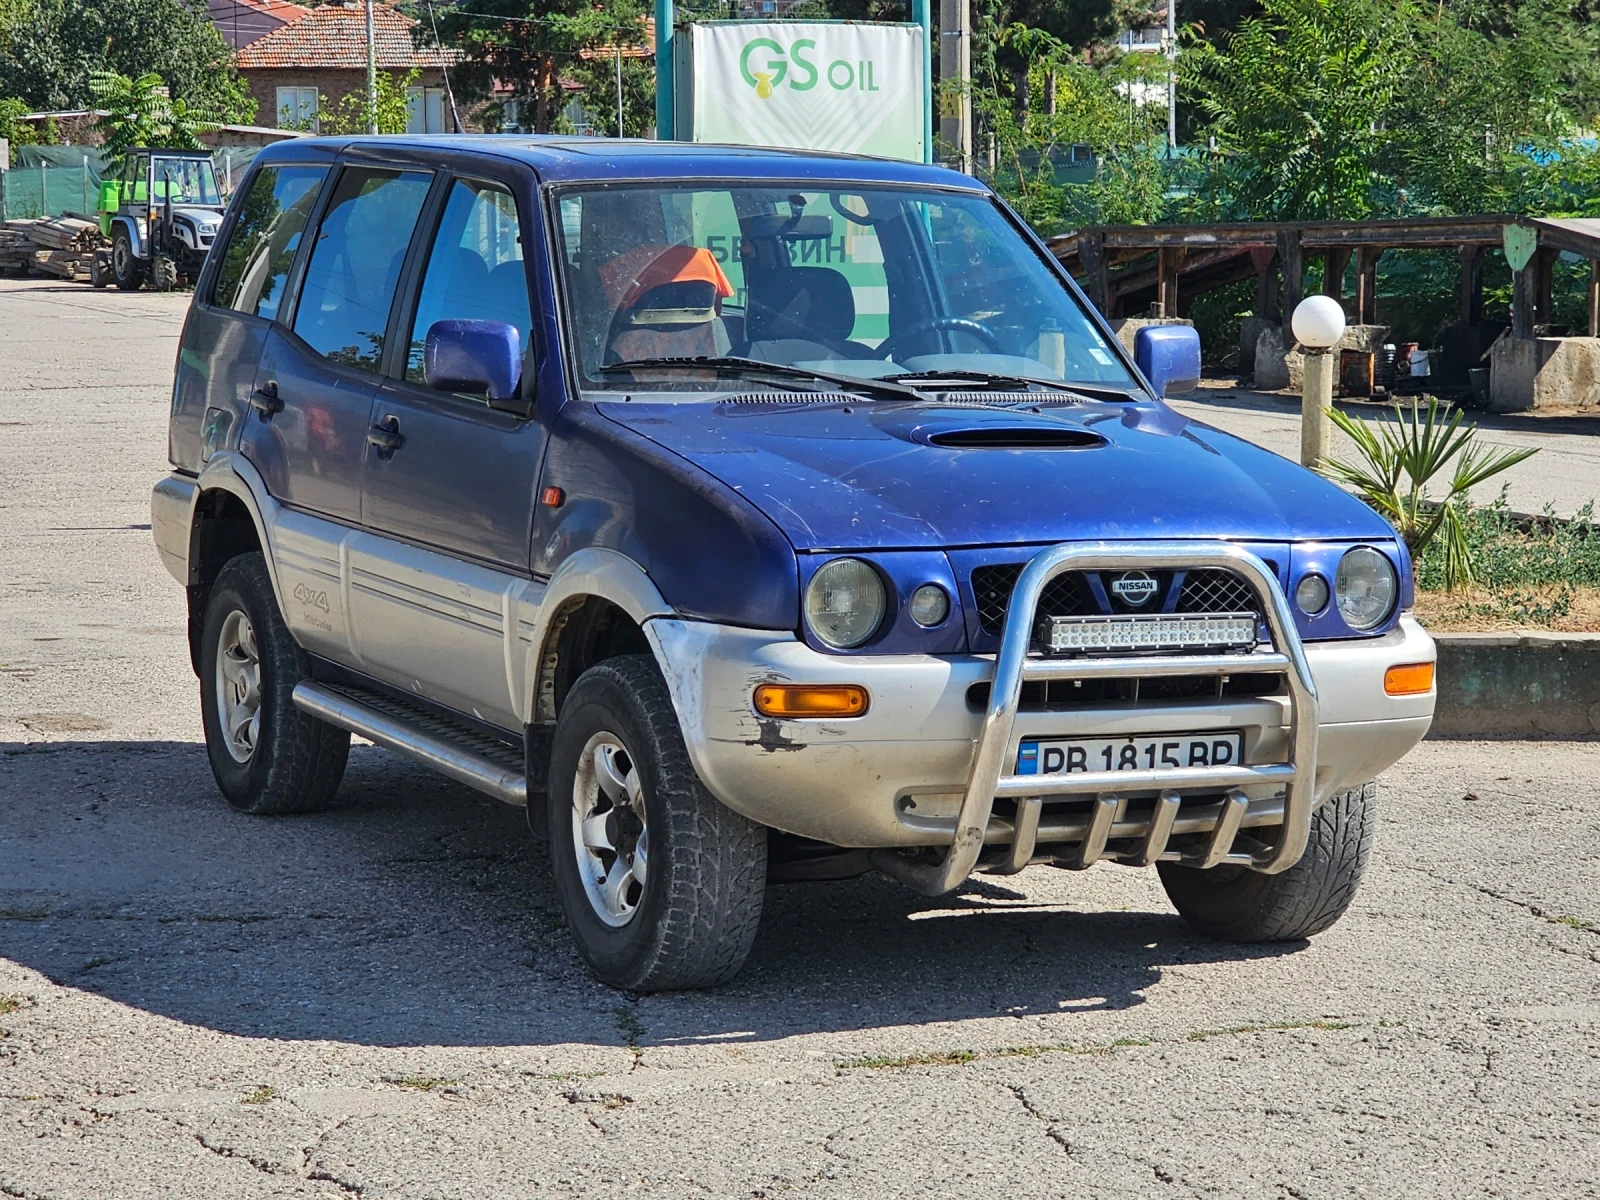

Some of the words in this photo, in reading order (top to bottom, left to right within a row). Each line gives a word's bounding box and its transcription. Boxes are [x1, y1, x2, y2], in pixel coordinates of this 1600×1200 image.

[739, 37, 819, 92] GS
[827, 59, 879, 92] OIL
[1118, 581, 1153, 591] NISSAN
[1101, 741, 1180, 773] 1815
